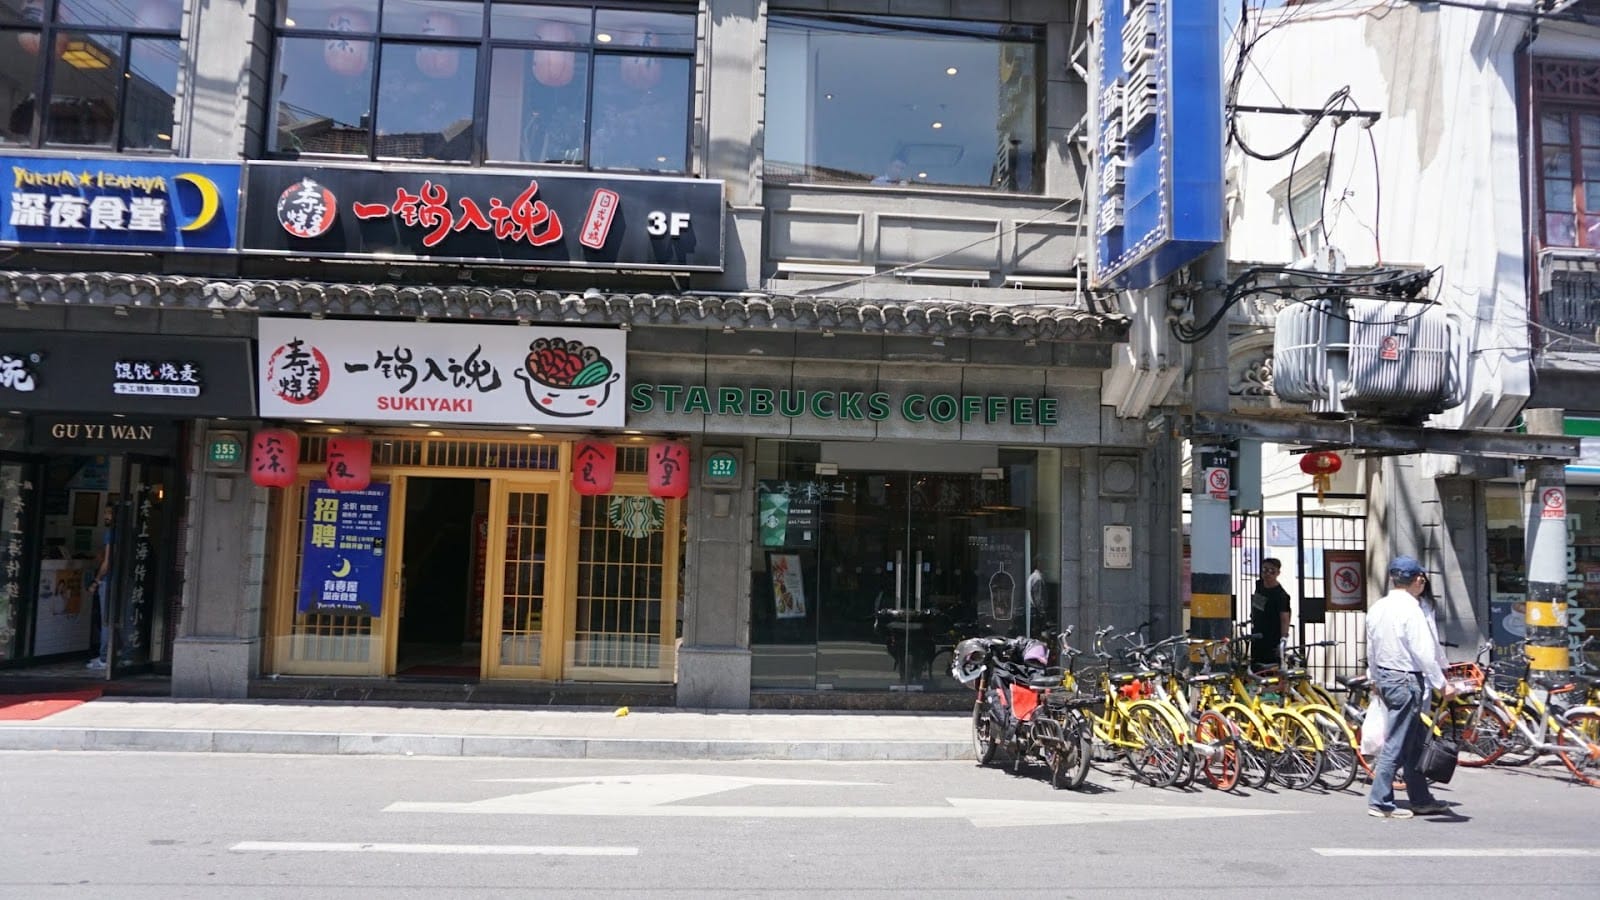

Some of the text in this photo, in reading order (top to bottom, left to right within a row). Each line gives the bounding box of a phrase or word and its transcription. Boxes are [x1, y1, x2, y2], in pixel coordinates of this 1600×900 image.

[10, 192, 165, 231] 深夜食堂
[353, 180, 563, 247] 一锅入魂
[647, 211, 690, 236] 3F
[345, 344, 502, 393] 一锅入魂
[377, 396, 473, 412] SUKIYAKI
[630, 383, 1058, 426] STARBUCKS COFFEE
[52, 424, 153, 440] GU YI WAN
[215, 443, 236, 454] 355
[712, 460, 732, 470] 357
[312, 498, 339, 548] 招聘
